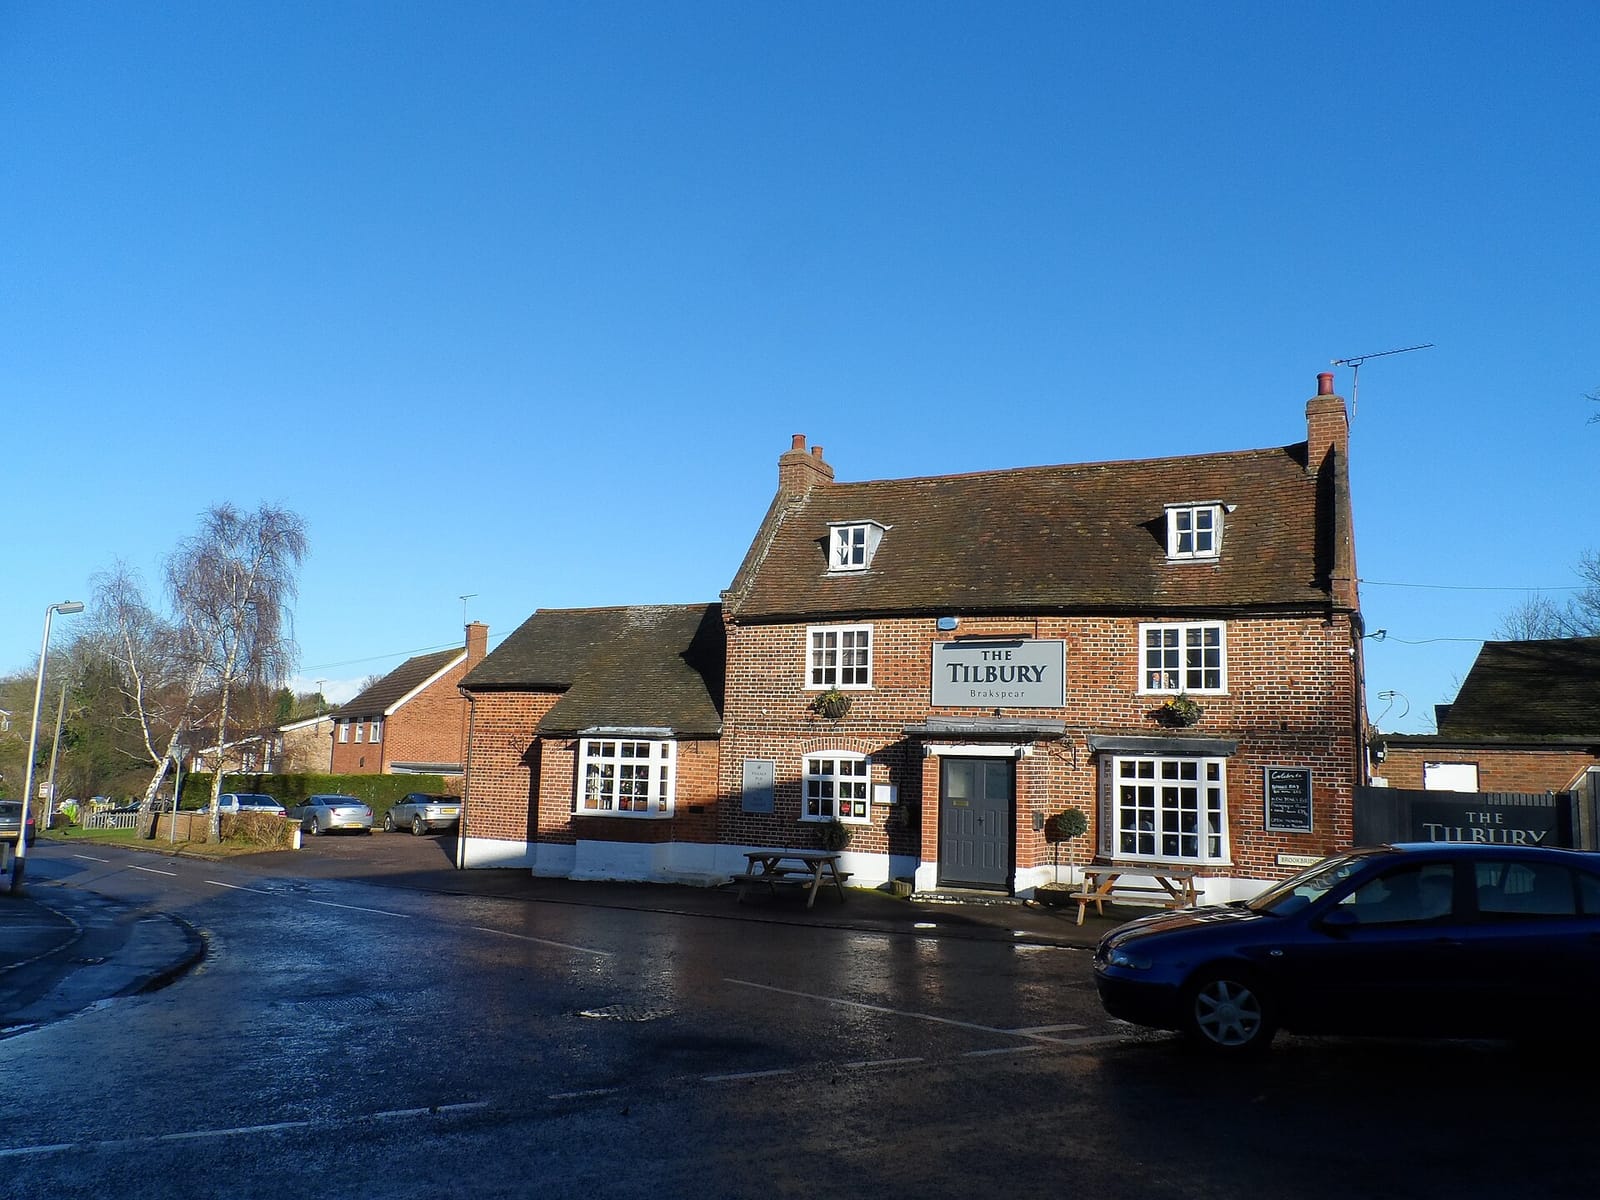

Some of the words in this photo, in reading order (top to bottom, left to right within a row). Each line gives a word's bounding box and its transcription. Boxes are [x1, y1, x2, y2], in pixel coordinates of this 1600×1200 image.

[981, 650, 1012, 661] THE
[946, 663, 1048, 683] TILBURY
[970, 689, 1025, 699] Brakspear
[1465, 811, 1504, 825] THE
